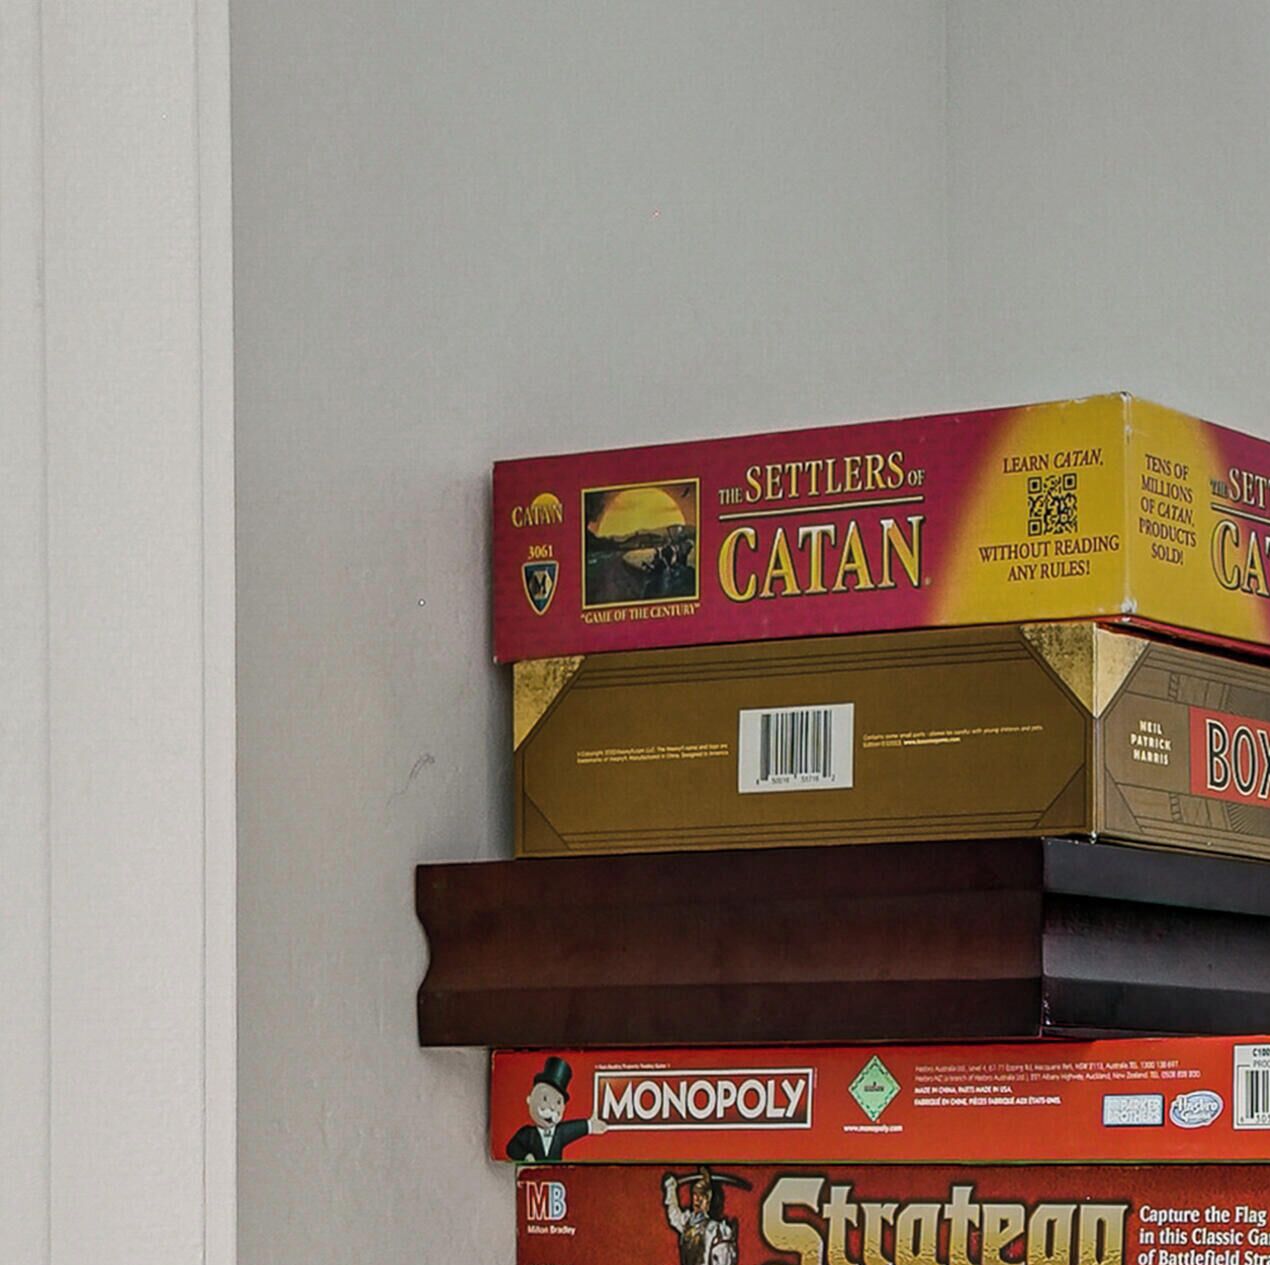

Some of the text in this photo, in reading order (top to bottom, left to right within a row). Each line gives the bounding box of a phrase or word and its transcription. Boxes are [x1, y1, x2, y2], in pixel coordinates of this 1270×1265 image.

[1003, 454, 1049, 474] LEARN
[1145, 453, 1190, 480] TENS OF
[718, 451, 926, 505] THE SETTLERS OF
[1141, 474, 1193, 504] MILLIONS
[512, 503, 563, 528] CATAN
[1140, 497, 1155, 514] OF
[1139, 517, 1197, 548] PRODUCTS
[528, 545, 553, 560] 3061
[718, 515, 926, 603] CATAN
[978, 535, 1120, 563] WITHOUT READING
[1152, 543, 1184, 565] SOLD!
[1007, 560, 1090, 581] ANY RULES!
[614, 610, 626, 621] OF
[630, 608, 649, 620] THE
[1140, 719, 1162, 735] NEIL
[1131, 733, 1171, 751] PATRICK
[1133, 748, 1169, 765] HARRIS
[602, 1078, 806, 1120] MONOPOLY
[526, 1181, 567, 1220] MB
[1139, 1205, 1267, 1230] Capture the Flag
[527, 1225, 576, 1235] Milton Bradley
[1139, 1228, 1154, 1245] in
[1157, 1228, 1188, 1245] this
[1191, 1227, 1244, 1246] Classic
